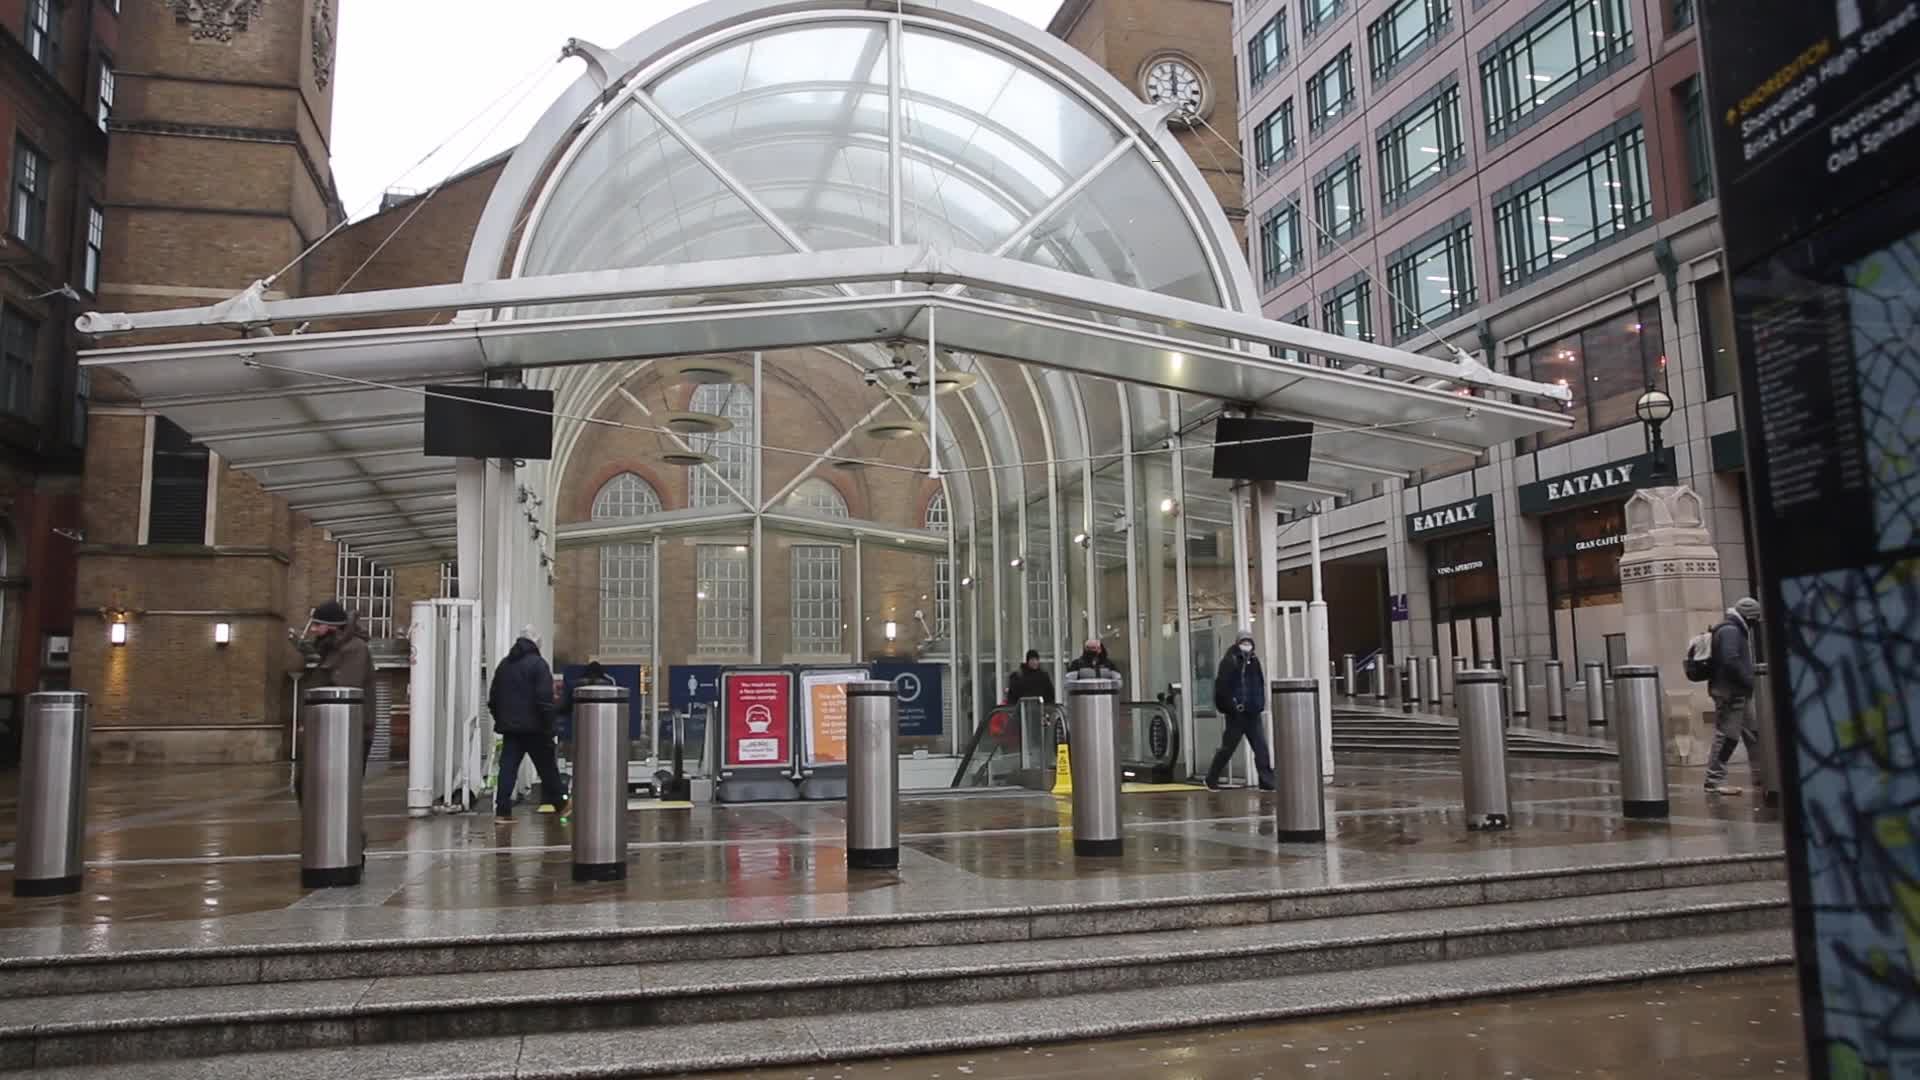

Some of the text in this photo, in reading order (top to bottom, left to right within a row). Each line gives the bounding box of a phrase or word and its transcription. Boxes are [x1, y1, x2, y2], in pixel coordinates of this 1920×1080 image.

[1741, 75, 1818, 138] Shoreditch
[1819, 47, 1859, 82] High
[1743, 103, 1816, 160] Brick Lane
[1827, 142, 1859, 173] Old
[1547, 463, 1635, 500] EATALY
[1412, 502, 1478, 532] EATALY
[1575, 541, 1595, 551] GRAN
